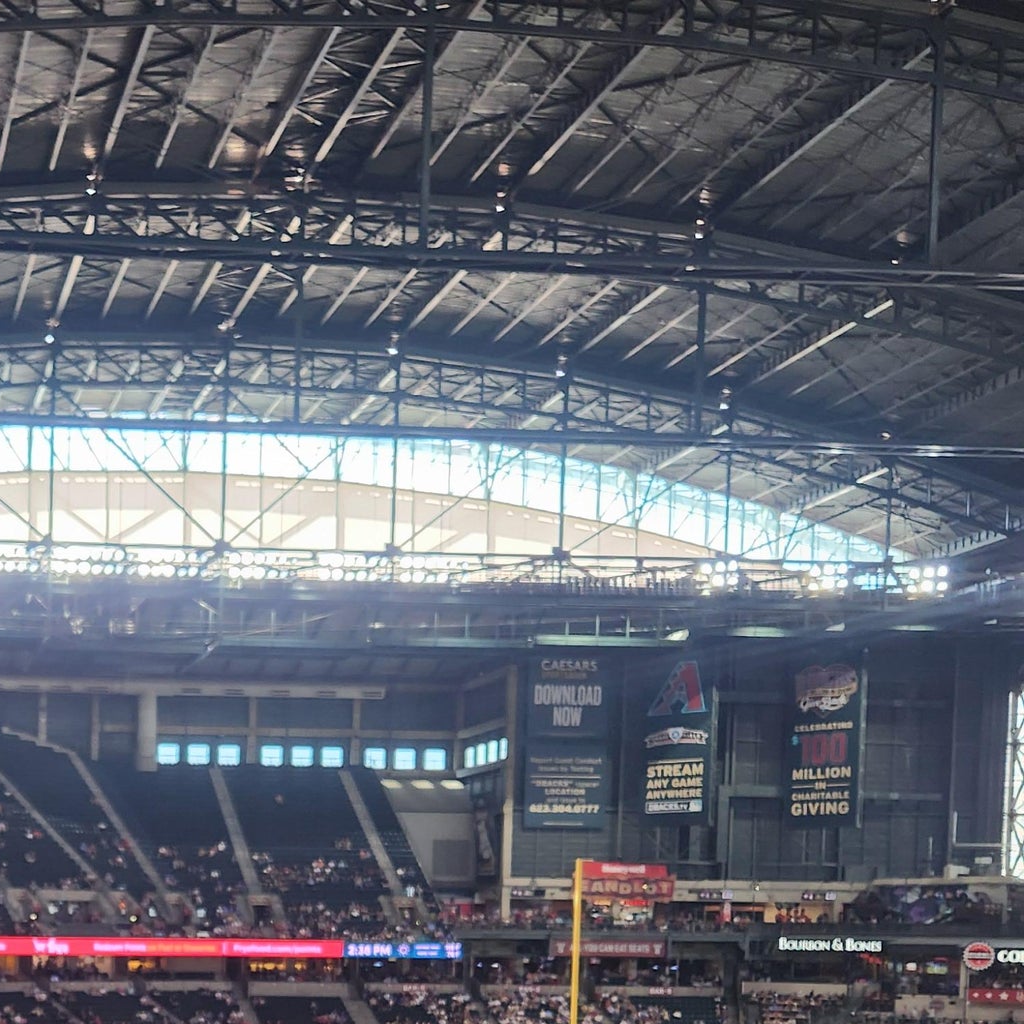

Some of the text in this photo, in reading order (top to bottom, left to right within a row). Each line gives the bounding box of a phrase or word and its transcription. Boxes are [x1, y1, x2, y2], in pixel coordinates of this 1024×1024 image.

[534, 685, 602, 706] DOWNLOAD
[553, 706, 583, 727] NOW
[646, 762, 704, 778] STREAM
[792, 766, 852, 780] MILLION
[646, 776, 703, 789] ANY GAME
[646, 787, 703, 800] ANYWHERE
[792, 792, 850, 801] CHARITABLE
[791, 801, 850, 817] GIVING
[778, 937, 882, 952] BOURBON & BONES
